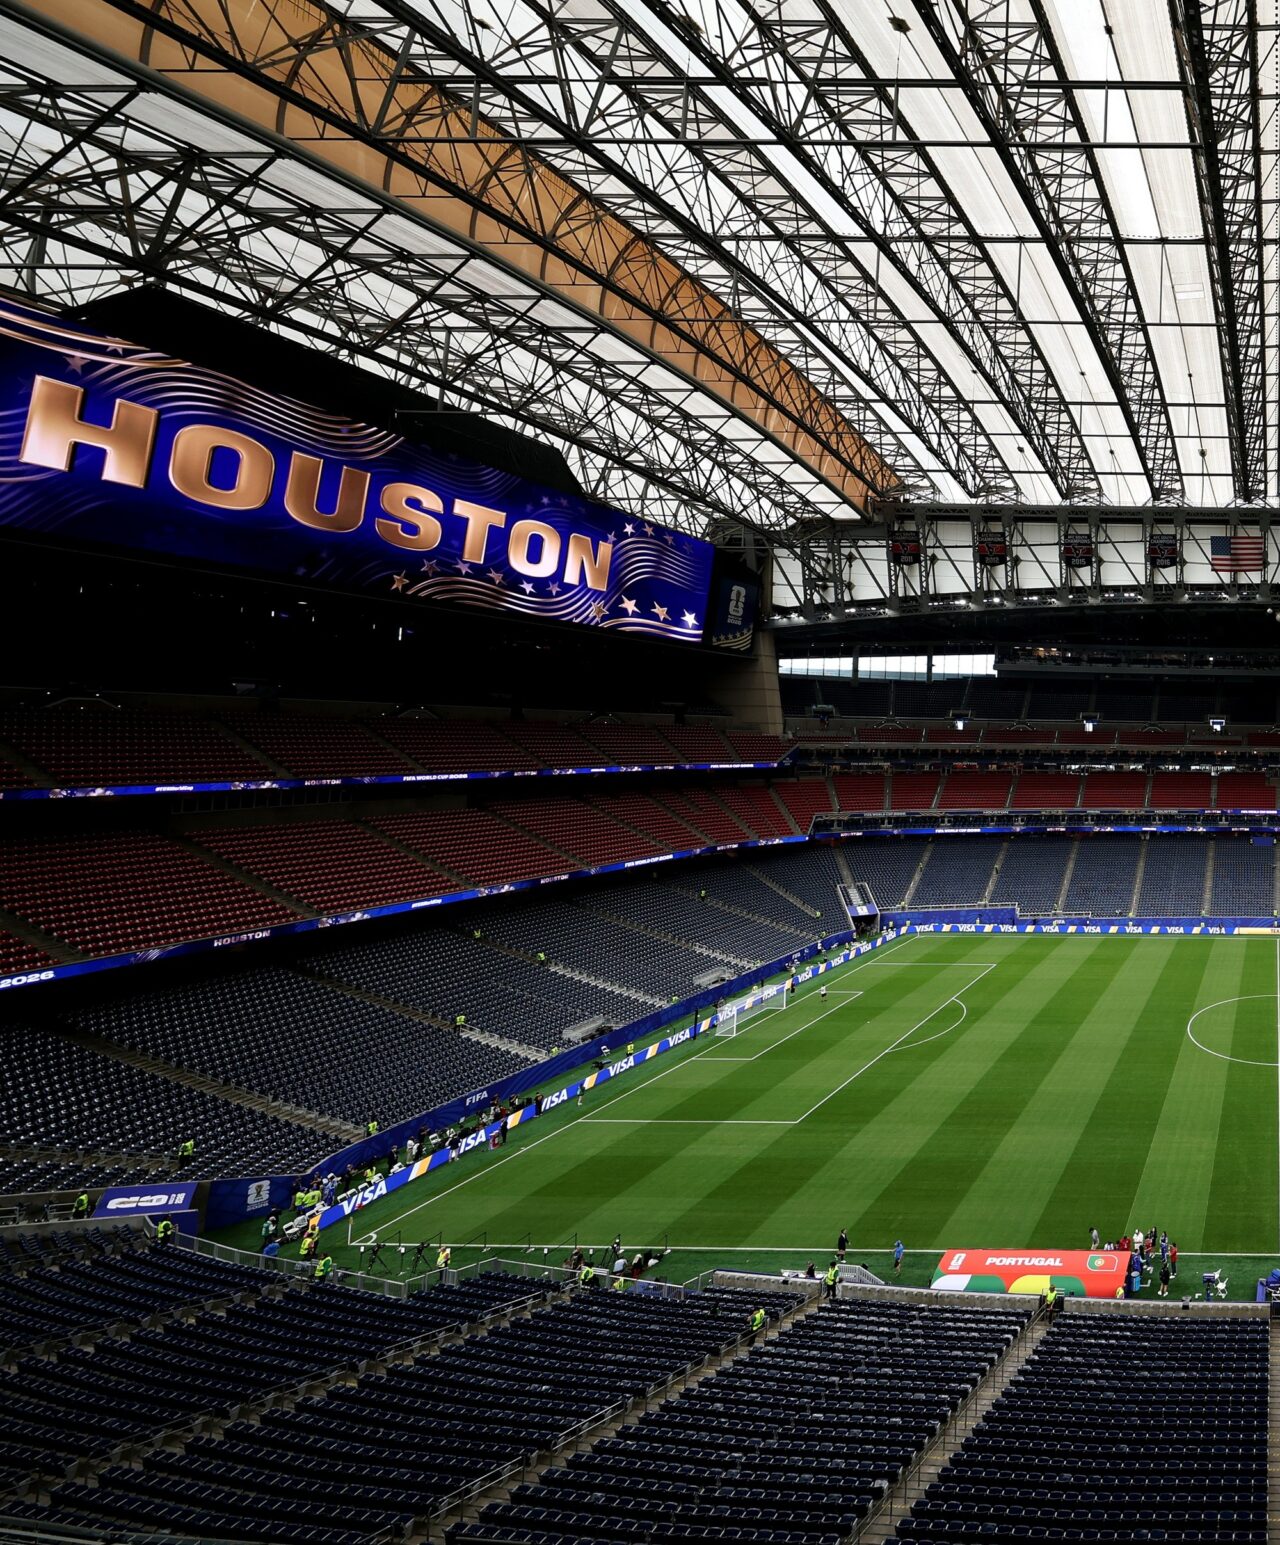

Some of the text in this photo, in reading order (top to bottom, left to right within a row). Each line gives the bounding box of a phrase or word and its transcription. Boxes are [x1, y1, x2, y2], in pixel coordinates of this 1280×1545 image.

[19, 374, 613, 592] HOUSTON
[1156, 558, 1172, 566] 2016
[305, 778, 342, 786] HOUSTON
[541, 873, 570, 884] HOUSTON
[914, 924, 934, 933] VISA
[957, 925, 976, 933] VISA
[999, 925, 1018, 933] VISA
[1083, 926, 1102, 934] VISA
[1124, 926, 1143, 934] VISA
[1166, 926, 1185, 934] VISA
[214, 928, 271, 947] HOUSTON
[0, 970, 54, 988] 2026
[798, 968, 812, 983] VISA
[719, 1003, 737, 1023] VISA
[668, 1029, 690, 1047] VISA
[609, 1055, 635, 1078] VISA
[466, 1090, 489, 1107] FIFA
[338, 1180, 388, 1216] VISA
[985, 1256, 1064, 1268] PORTUGAL
